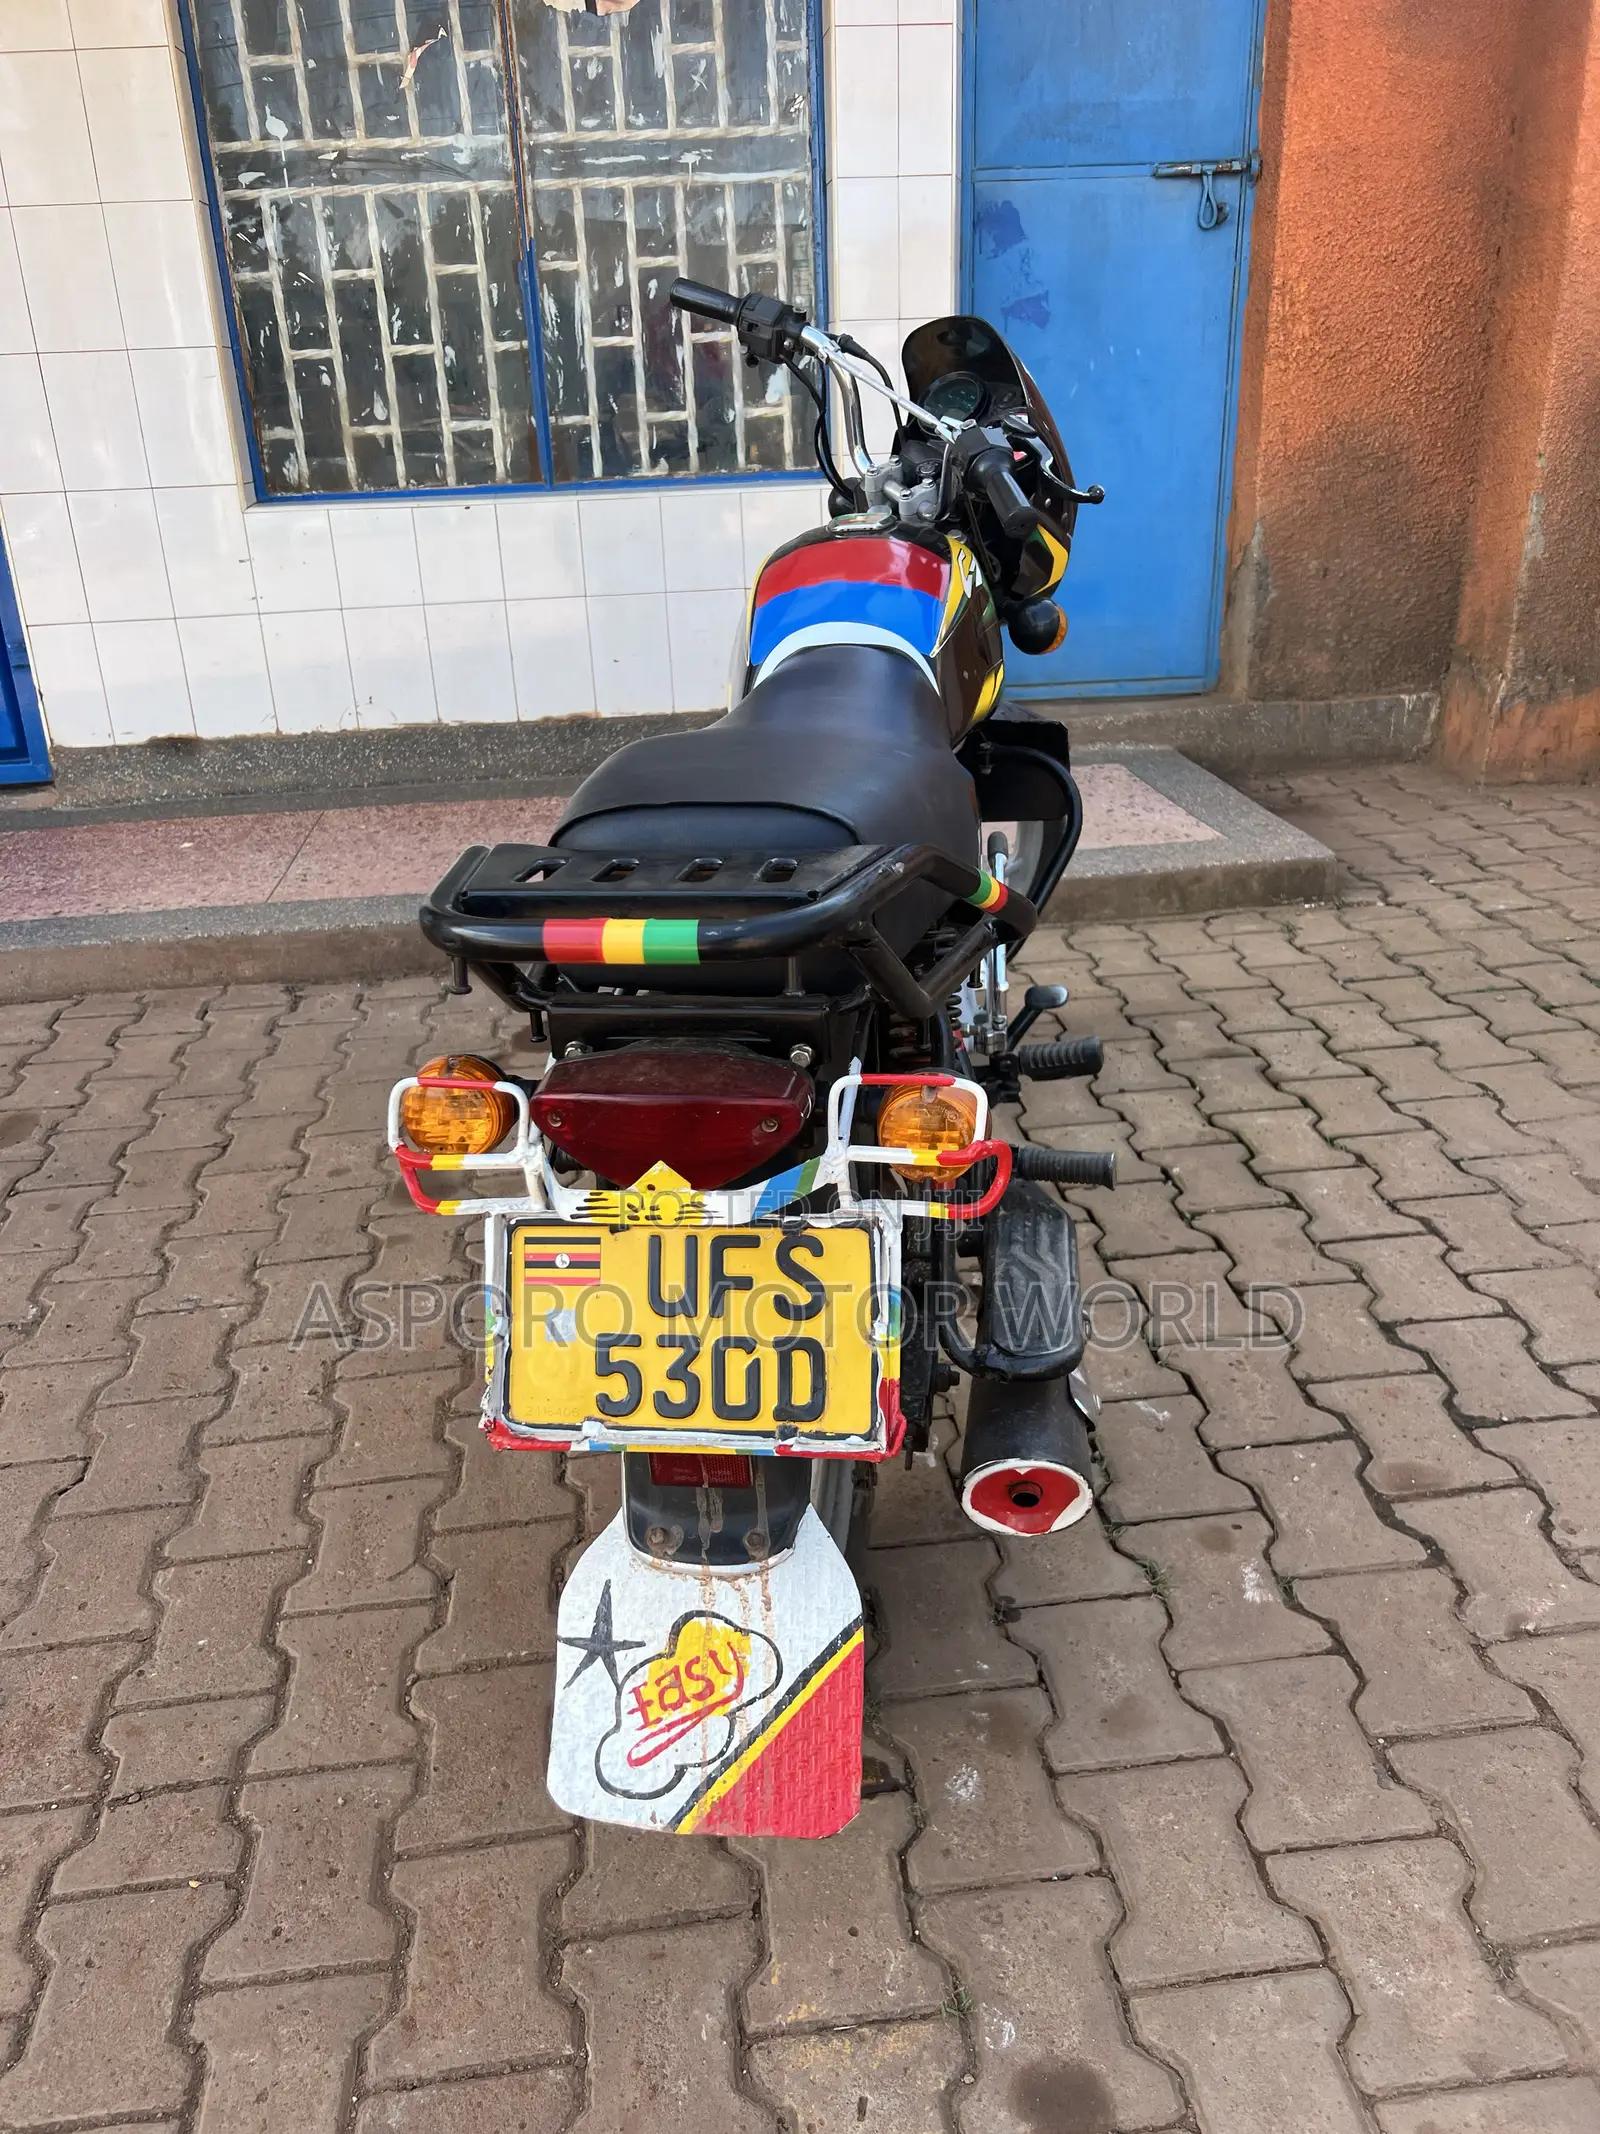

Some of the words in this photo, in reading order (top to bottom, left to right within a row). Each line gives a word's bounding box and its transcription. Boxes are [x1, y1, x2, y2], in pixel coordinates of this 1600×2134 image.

[648, 1234, 826, 1321] UFS
[595, 1332, 827, 1422] 530D
[626, 1641, 745, 1769] Easy
